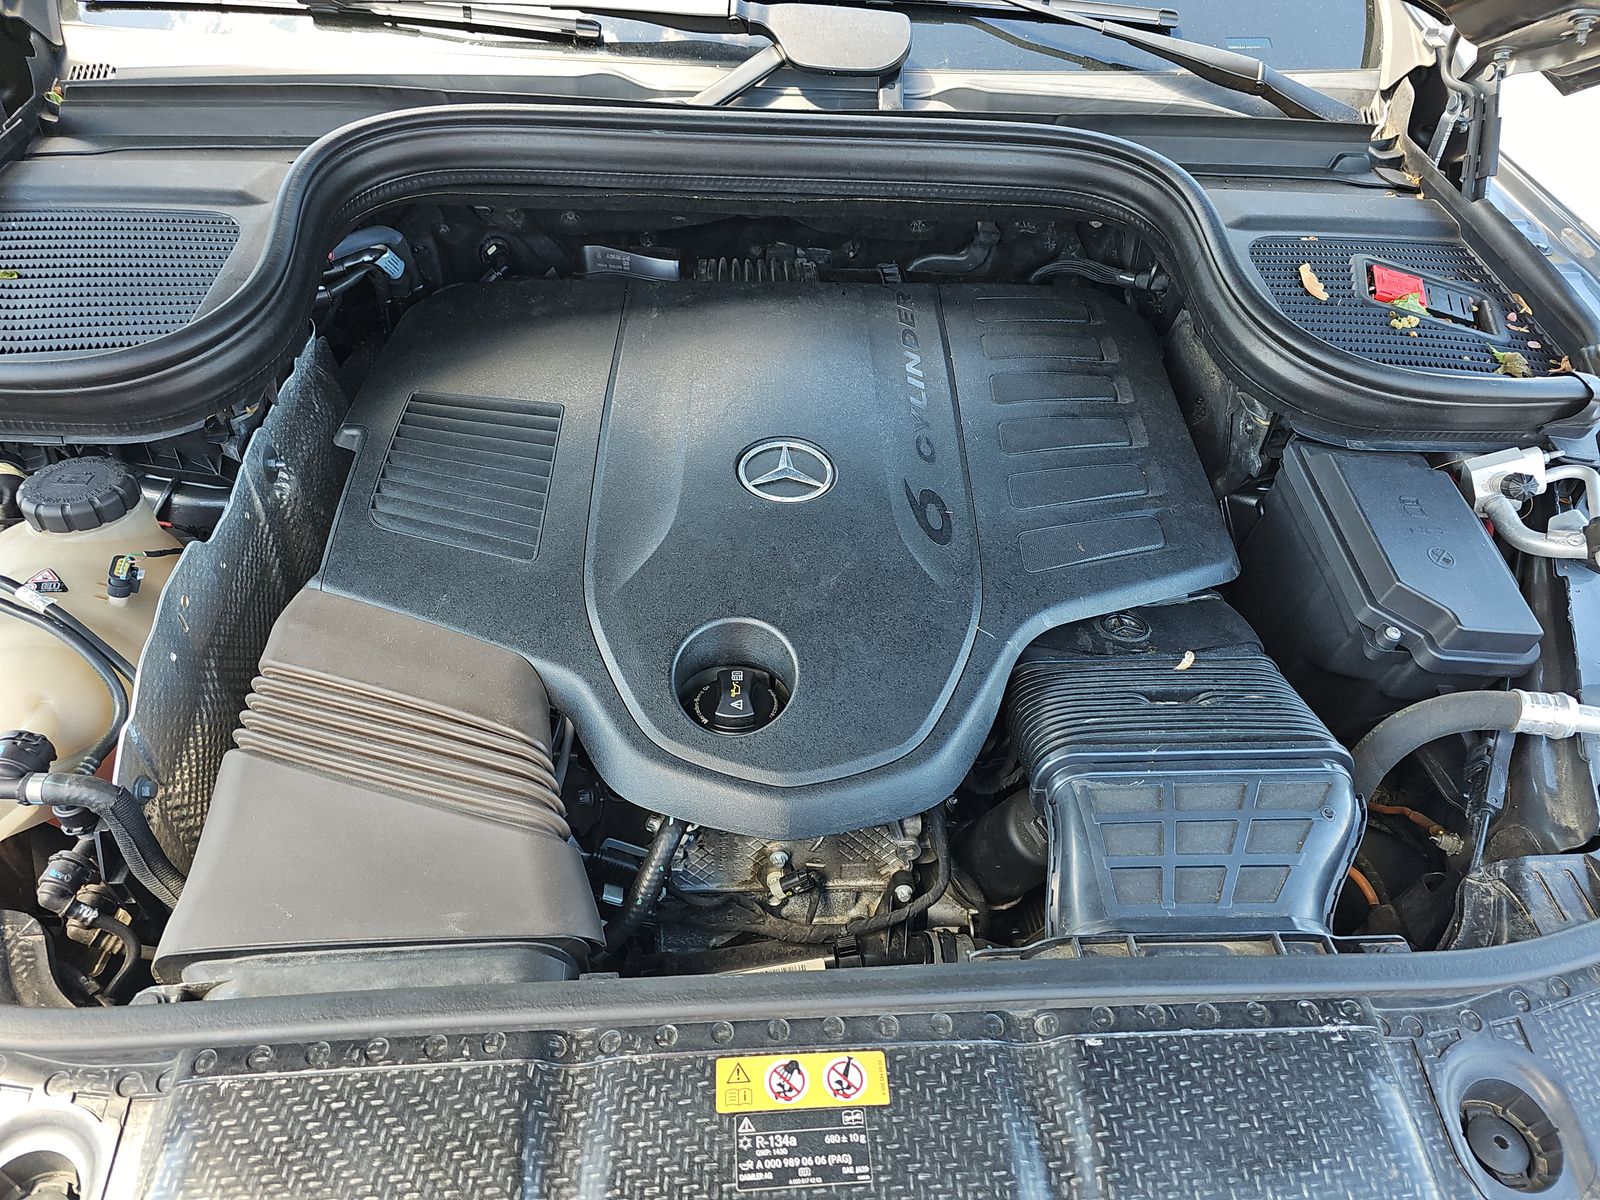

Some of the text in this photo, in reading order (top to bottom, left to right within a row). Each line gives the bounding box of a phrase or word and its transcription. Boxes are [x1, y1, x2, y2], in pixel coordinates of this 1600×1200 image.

[896, 290, 953, 546] 6 CYLINDER
[79, 903, 99, 926] TOP
[756, 1134, 798, 1149] R-134a
[755, 1149, 772, 1157] GWP:
[755, 1153, 853, 1170] A 000 989 06 06 (PAG)
